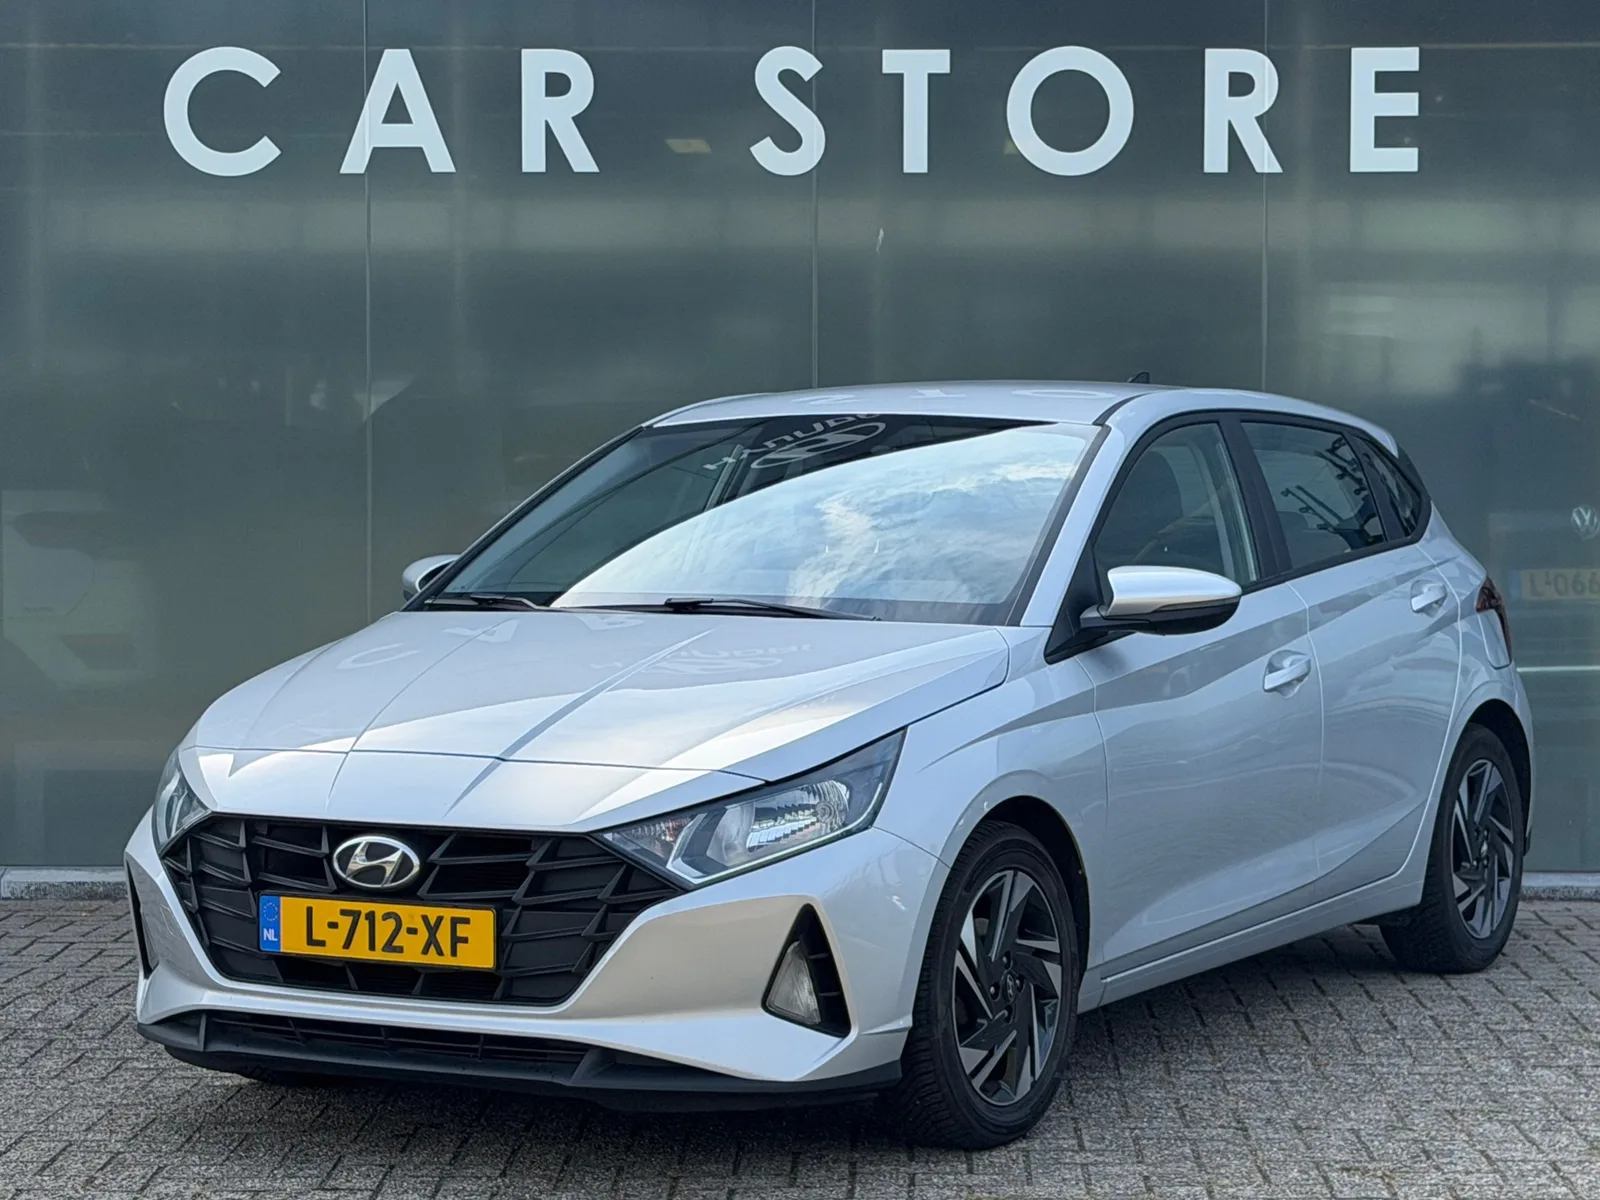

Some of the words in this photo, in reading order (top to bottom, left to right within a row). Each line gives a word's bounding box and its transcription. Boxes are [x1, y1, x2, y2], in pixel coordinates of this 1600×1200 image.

[164, 46, 599, 176] CAR
[751, 46, 1419, 176] STORE
[263, 928, 278, 942] NL
[306, 906, 471, 958] L-712-XF
